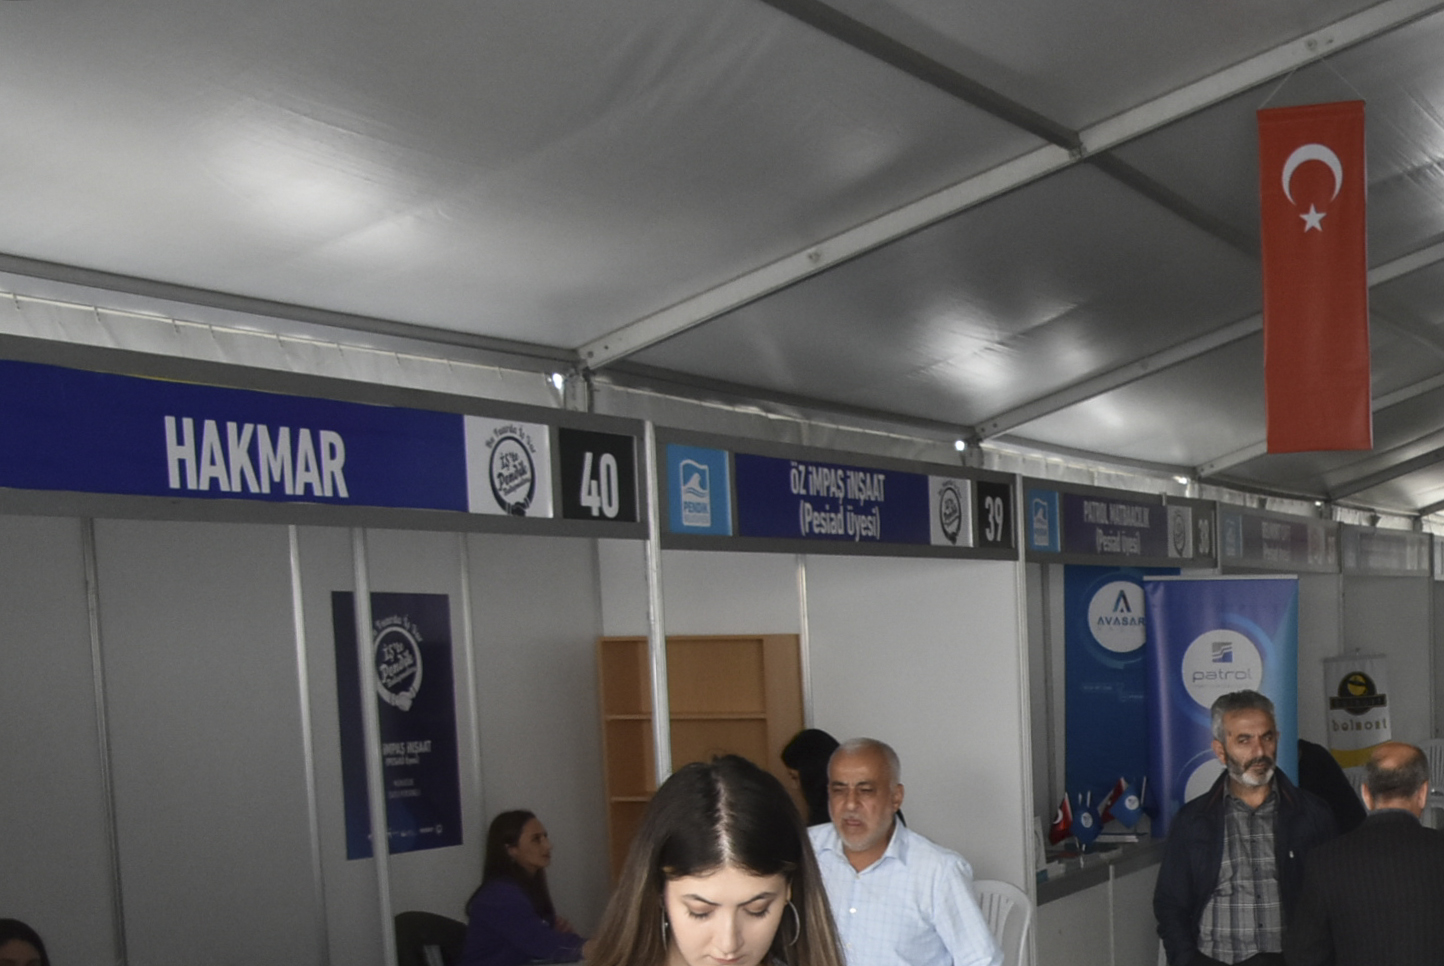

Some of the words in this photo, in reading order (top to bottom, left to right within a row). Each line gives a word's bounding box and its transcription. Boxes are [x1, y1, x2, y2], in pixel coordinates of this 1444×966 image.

[164, 415, 349, 498] HAKMAR
[581, 452, 619, 518] 40
[790, 461, 807, 495] ÖZ
[808, 466, 845, 504] İMPAŞ
[846, 471, 885, 506] İNŞAAT
[799, 500, 845, 537] (Pesiad
[984, 496, 1003, 541] 39
[1192, 668, 1252, 683] patrol
